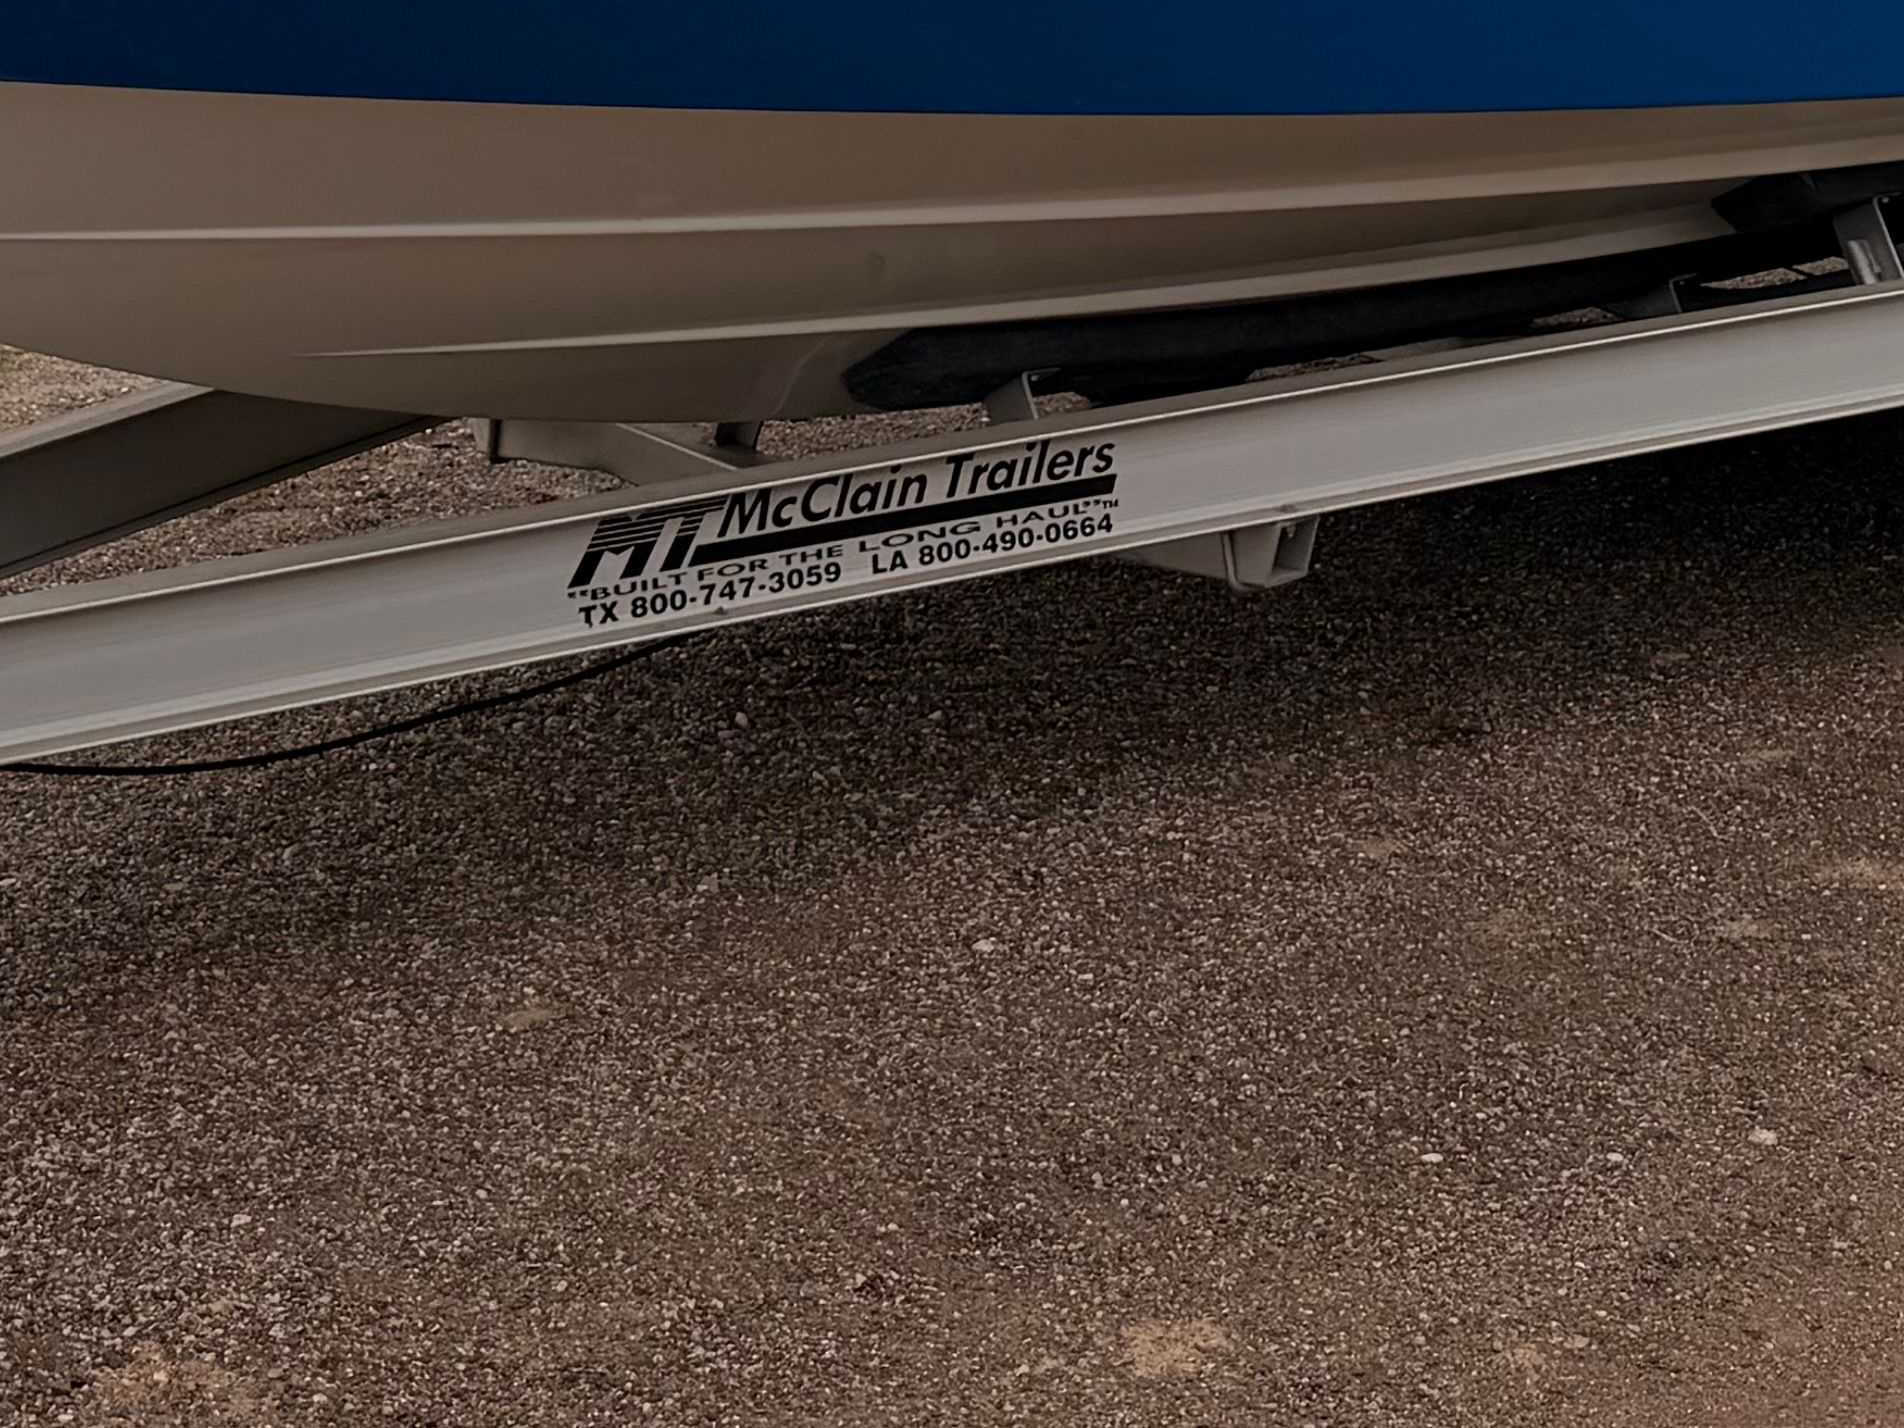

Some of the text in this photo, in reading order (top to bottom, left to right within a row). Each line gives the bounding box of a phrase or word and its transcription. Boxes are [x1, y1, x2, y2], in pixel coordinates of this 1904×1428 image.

[717, 439, 1115, 539] McClain Trailers
[579, 513, 1113, 628] TX 800-747-3059 LA 800-490-0664
[698, 559, 768, 582] FOR
[779, 544, 844, 566] THE
[859, 521, 981, 553] LONG
